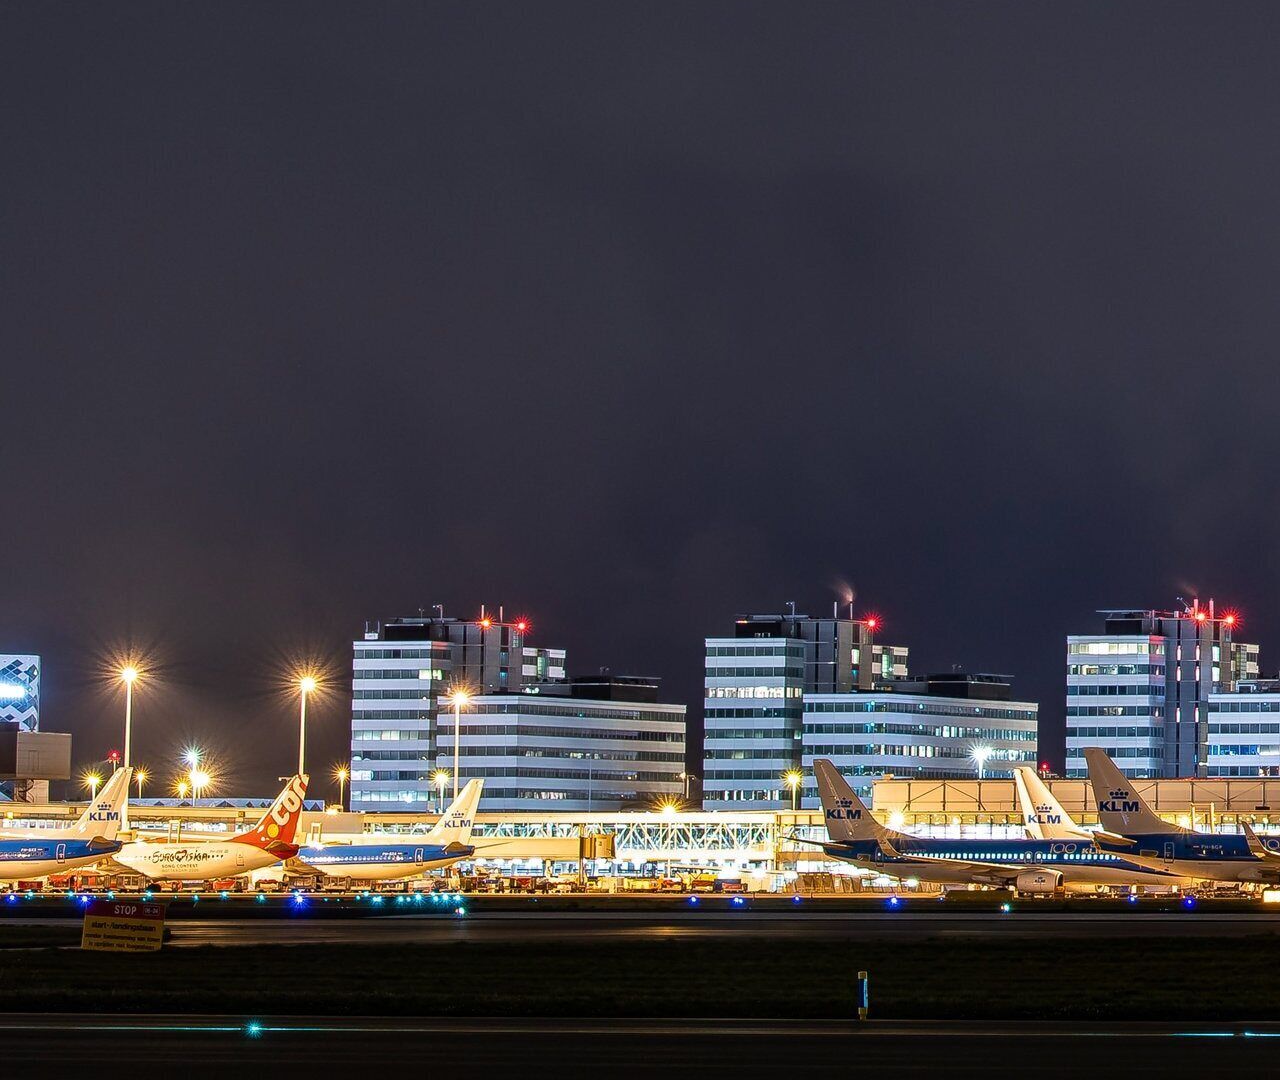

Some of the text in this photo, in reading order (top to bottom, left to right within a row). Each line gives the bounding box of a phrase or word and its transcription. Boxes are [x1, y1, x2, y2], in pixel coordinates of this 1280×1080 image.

[1099, 801, 1139, 812] KLM
[89, 812, 119, 821] KLM
[826, 809, 862, 819] KLM
[1027, 814, 1061, 824] KLM
[444, 820, 471, 828] KLM
[1049, 843, 1077, 854] 100
[114, 905, 137, 915] STOP
